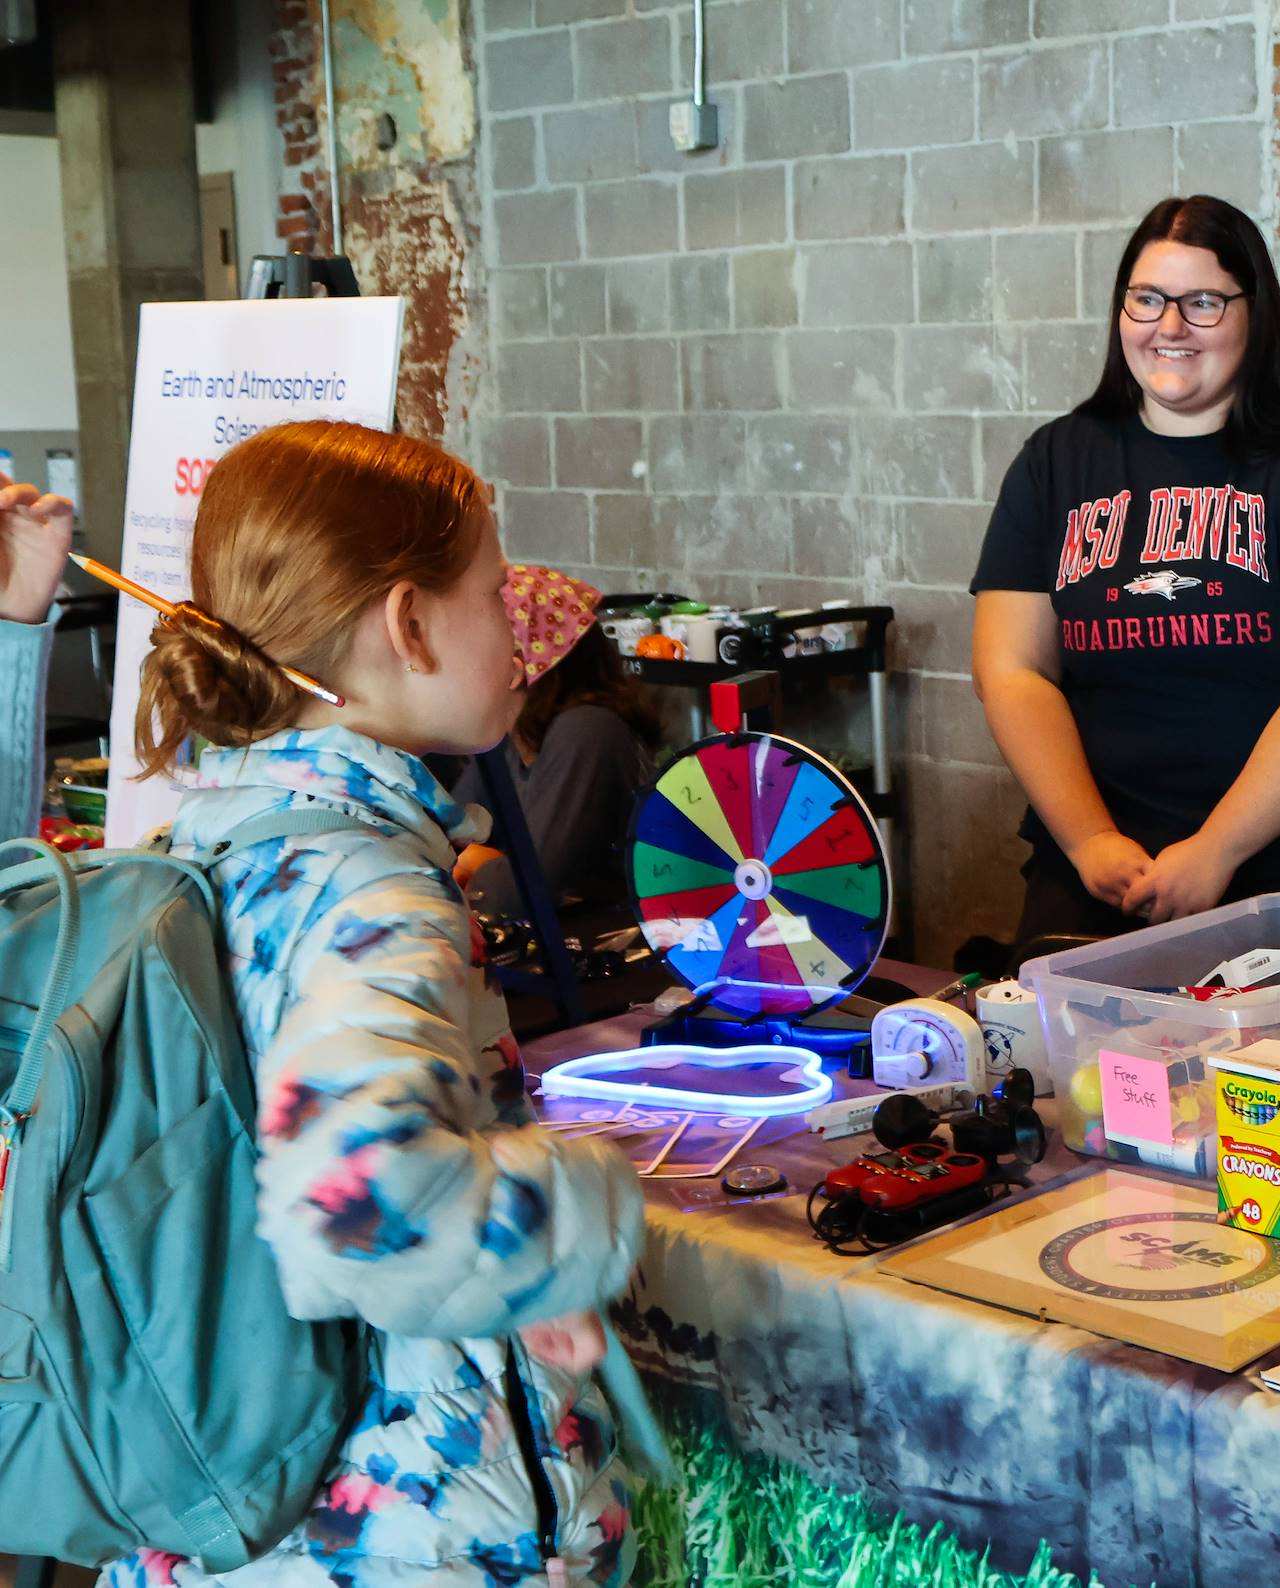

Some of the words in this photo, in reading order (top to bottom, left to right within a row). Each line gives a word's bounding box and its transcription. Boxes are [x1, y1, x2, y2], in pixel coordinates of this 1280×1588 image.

[161, 369, 201, 399] Earth
[205, 370, 236, 399] and
[240, 371, 347, 406] Atmospheric
[1139, 483, 1270, 583] DENVER
[1105, 587, 1120, 602] 19
[1206, 581, 1223, 597] 65
[1062, 611, 1272, 652] ROADRUNNERS
[1113, 1065, 1140, 1086] Free
[1225, 1081, 1277, 1106] Crayola
[1242, 1201, 1261, 1220] 48
[1119, 1230, 1244, 1267] SCAMS
